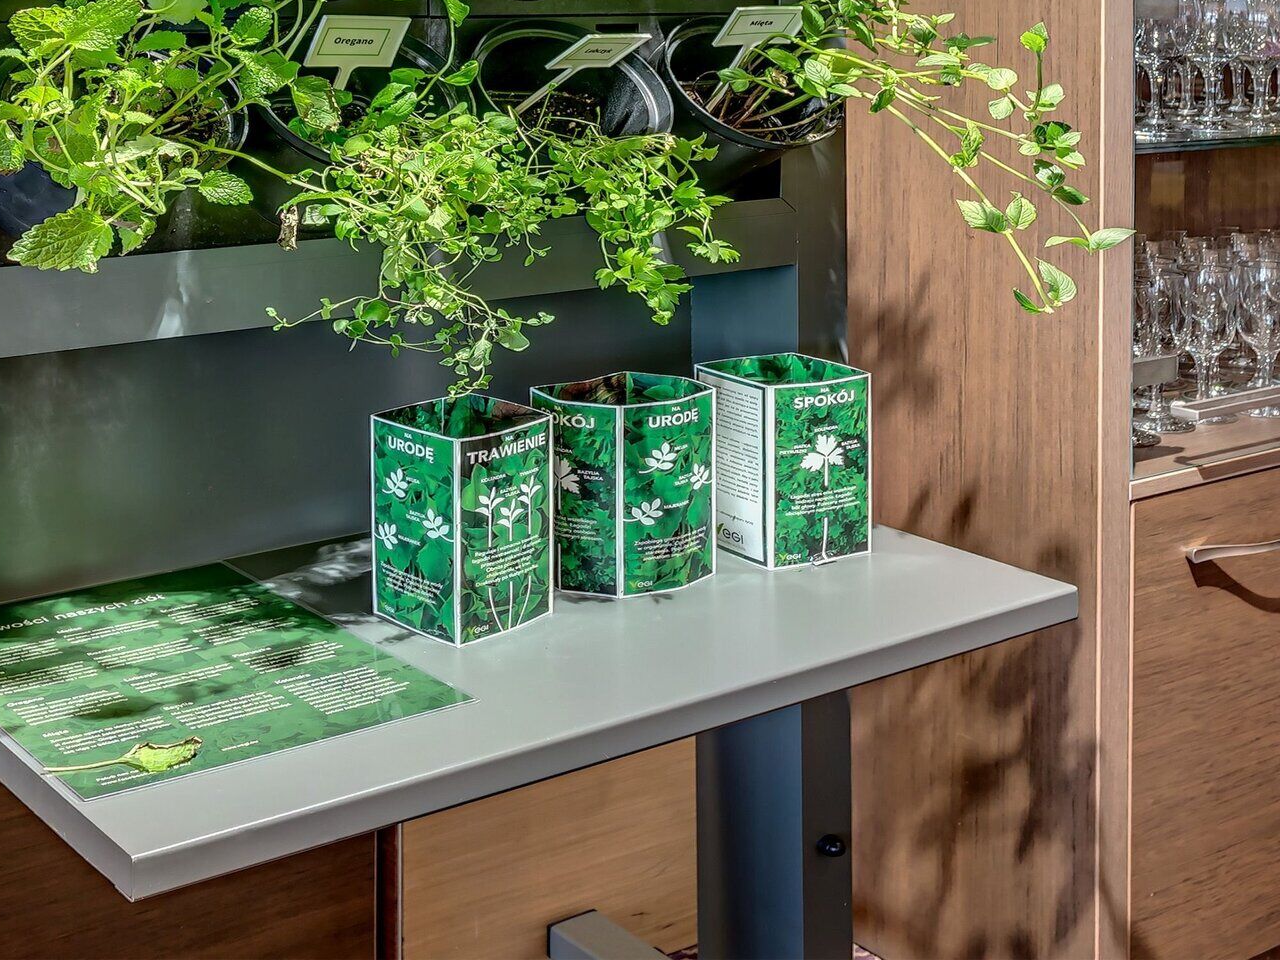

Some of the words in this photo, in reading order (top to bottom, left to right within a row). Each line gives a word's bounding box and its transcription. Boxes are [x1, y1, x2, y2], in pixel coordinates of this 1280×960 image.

[334, 37, 375, 46] Oregano
[794, 389, 856, 410] SPOKÓJ
[541, 407, 596, 429] OKÓJ
[648, 408, 699, 428] URODĘ
[388, 435, 435, 464] URODĘ
[466, 432, 547, 465] TRAWIENIE
[54, 600, 128, 621] naszych
[131, 593, 166, 606] ziół
